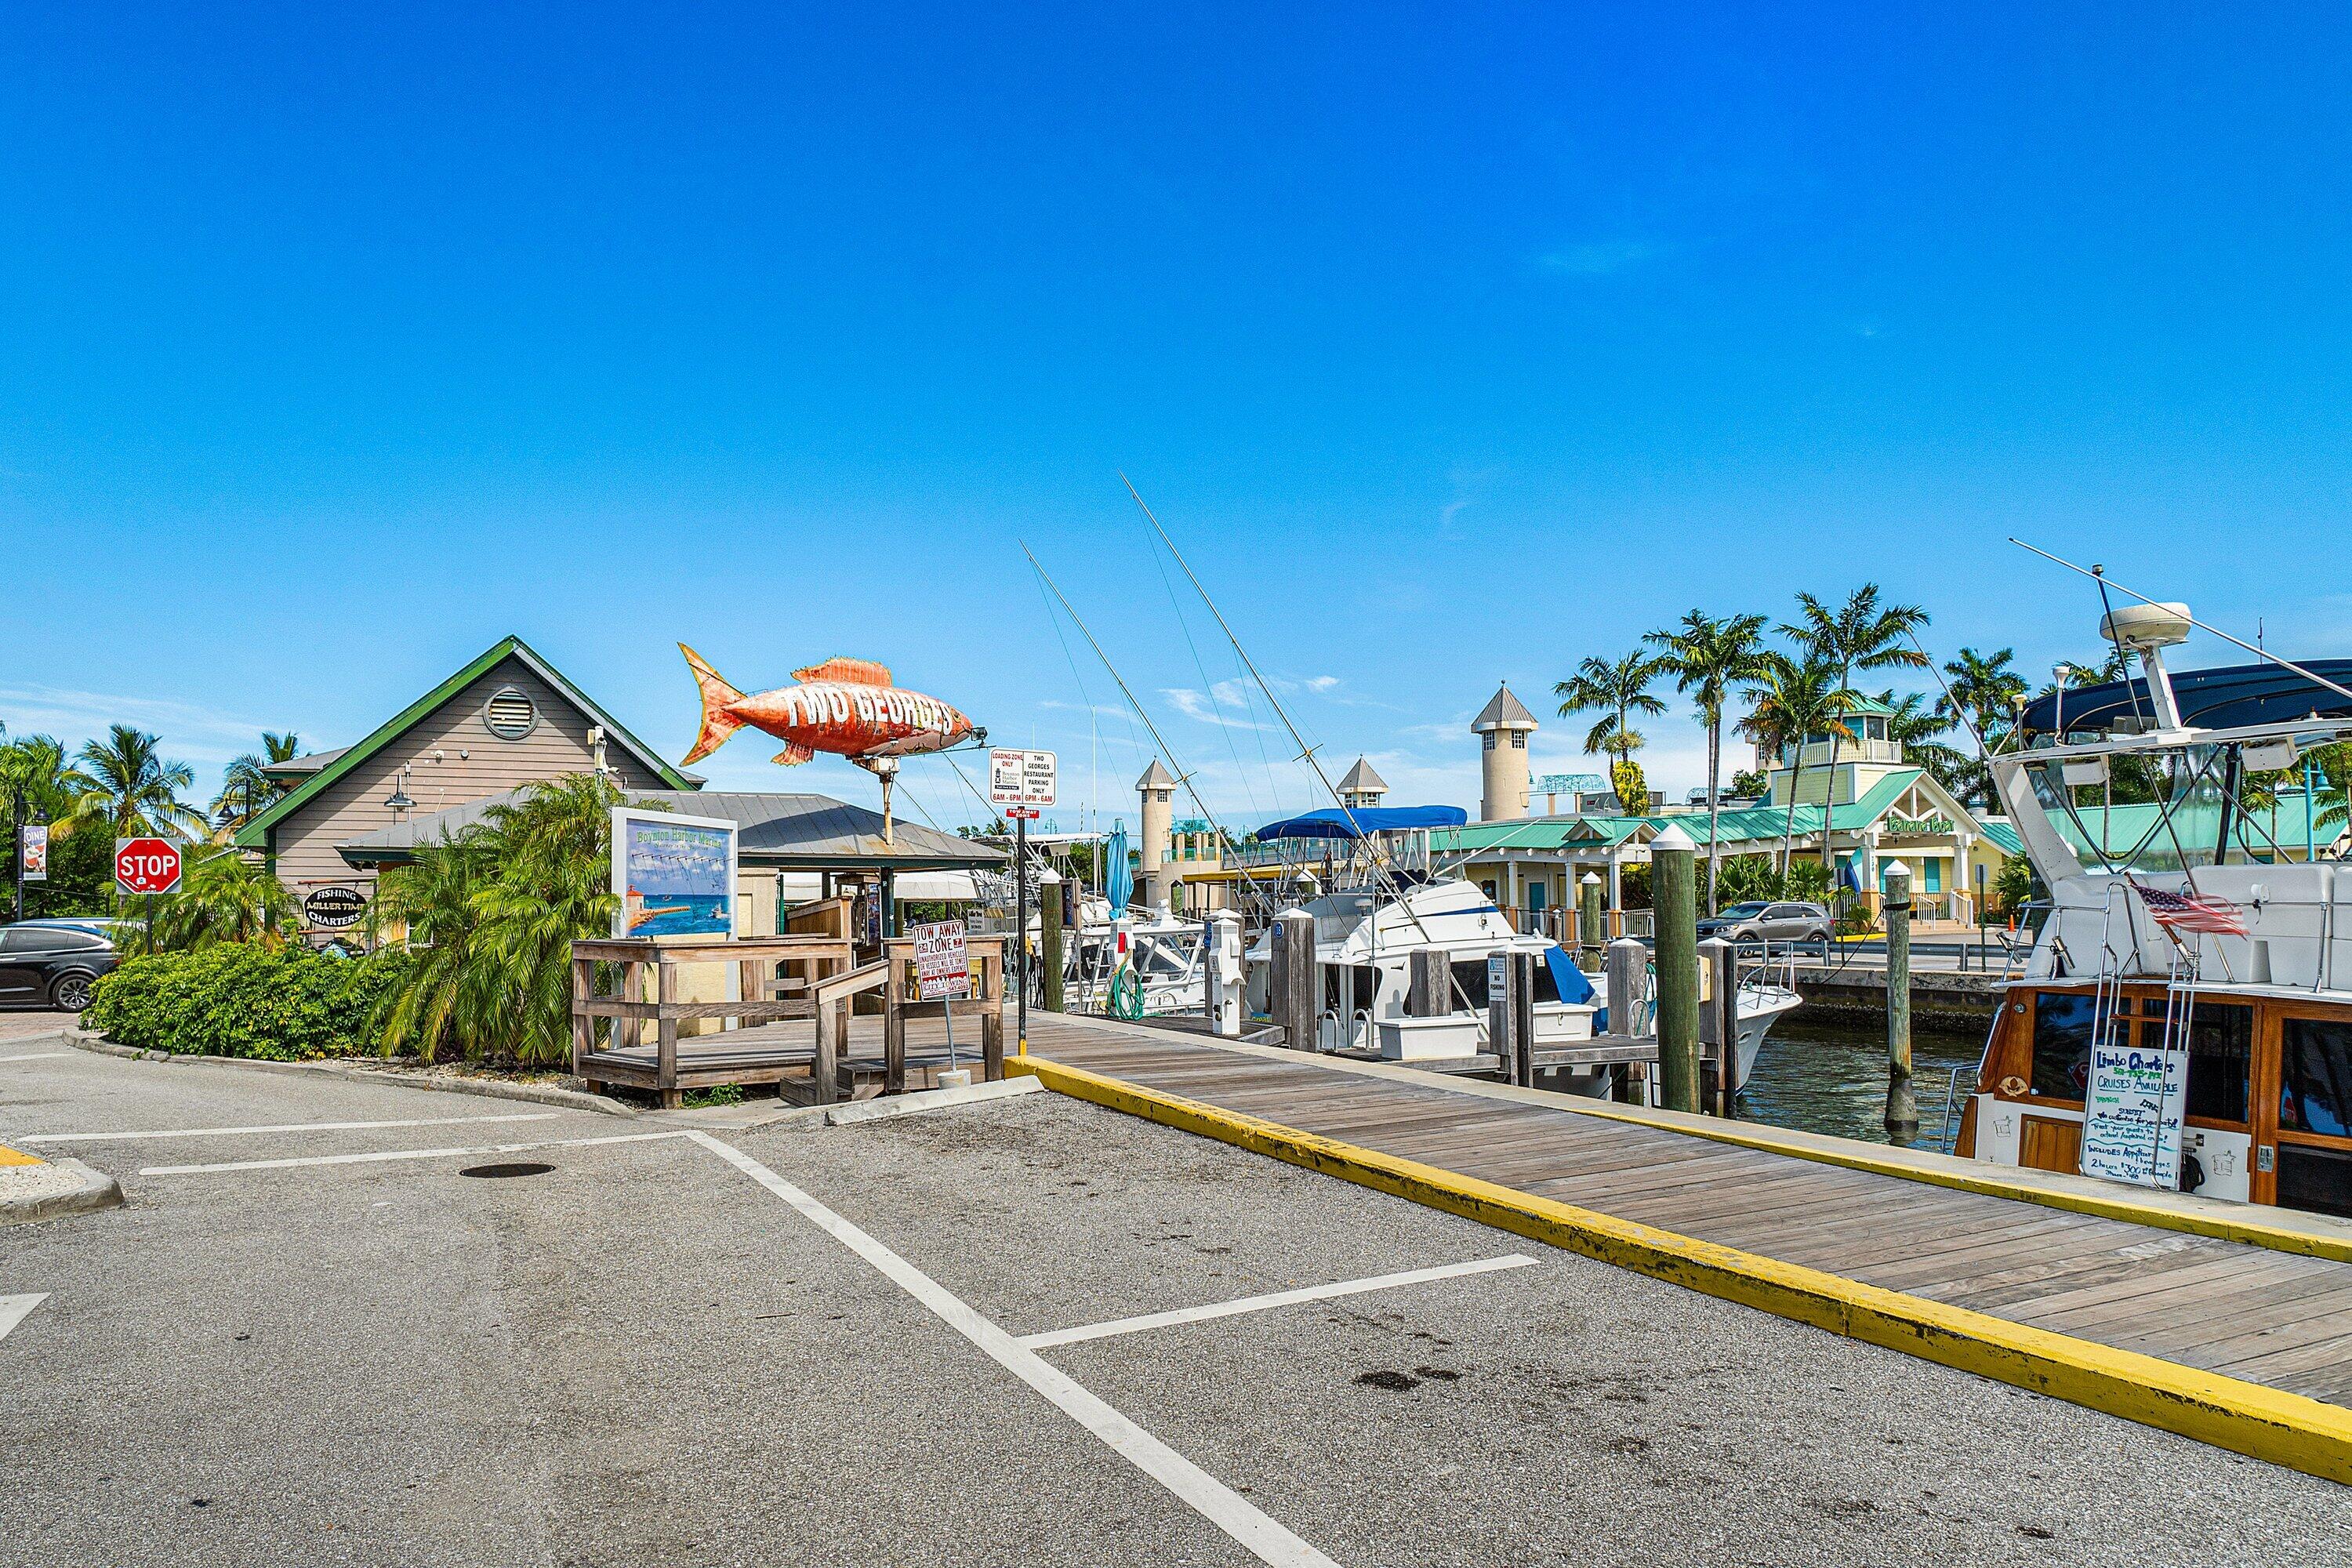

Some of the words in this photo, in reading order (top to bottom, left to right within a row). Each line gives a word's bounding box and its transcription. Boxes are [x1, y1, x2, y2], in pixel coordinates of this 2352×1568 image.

[785, 686, 849, 727] TWO
[852, 687, 953, 736] GEORGES
[1887, 817, 1928, 832] Banana
[1930, 818, 1955, 833] Boat
[26, 831, 45, 842] DINE
[637, 829, 670, 844] Boynton
[671, 828, 696, 843] Harbor
[699, 832, 722, 848] Marina
[121, 855, 176, 877] STOP
[317, 889, 356, 901] FISHING
[307, 902, 341, 910] MILLER
[309, 912, 361, 926] CHARTERS
[916, 927, 934, 941] TOW
[938, 923, 960, 939] AWAY
[929, 938, 953, 953] ZONE
[920, 953, 946, 963] UNAUTHORIZED
[947, 950, 965, 959] VEHICLES
[926, 961, 940, 970] VESSELS
[951, 964, 966, 973] EXPENSE
[924, 981, 939, 991] CITY
[942, 978, 967, 987] TOWING
[2096, 1051, 2126, 1068] Limbo
[2097, 1075, 2131, 1089] CRUISES
[2088, 1145, 2121, 1156] INCLUDES
[2091, 1158, 2098, 1167] 2
[2100, 1160, 2118, 1169] hours
